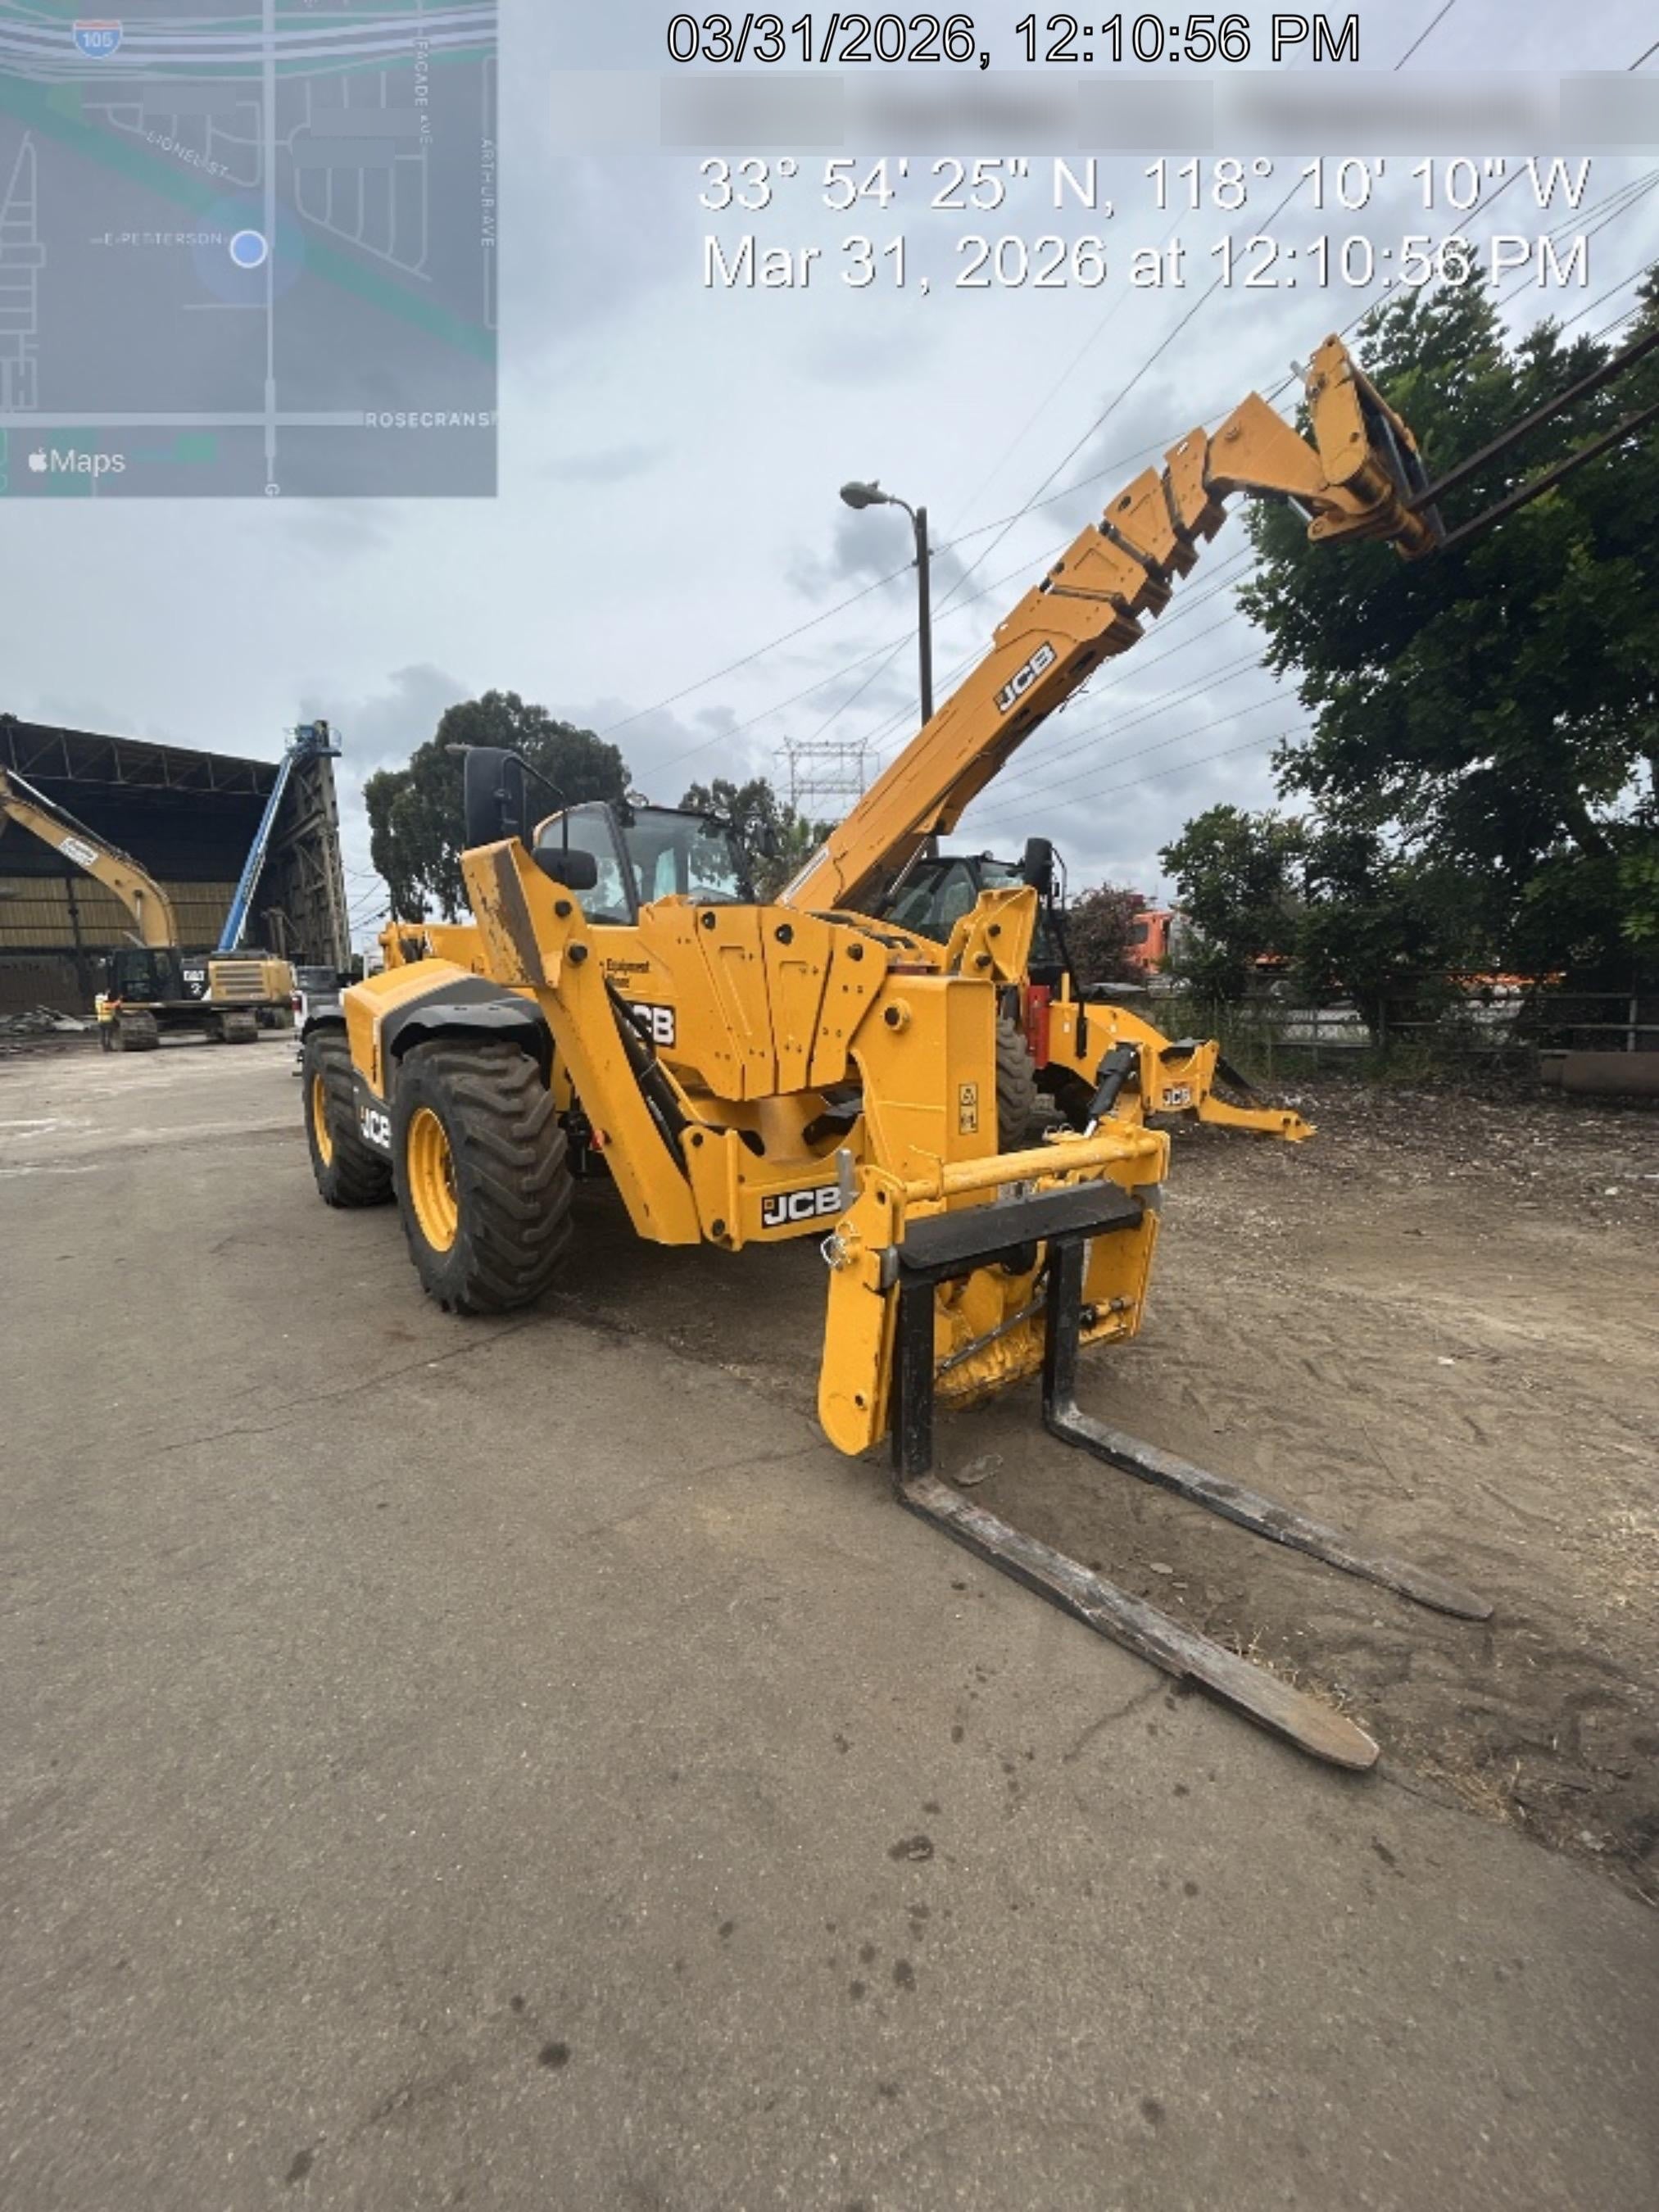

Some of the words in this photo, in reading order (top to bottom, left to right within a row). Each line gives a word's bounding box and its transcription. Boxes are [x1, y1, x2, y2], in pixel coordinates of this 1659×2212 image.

[998, 644, 1057, 712] JCB
[360, 1106, 392, 1149] JCB
[764, 1186, 842, 1225] JCB
